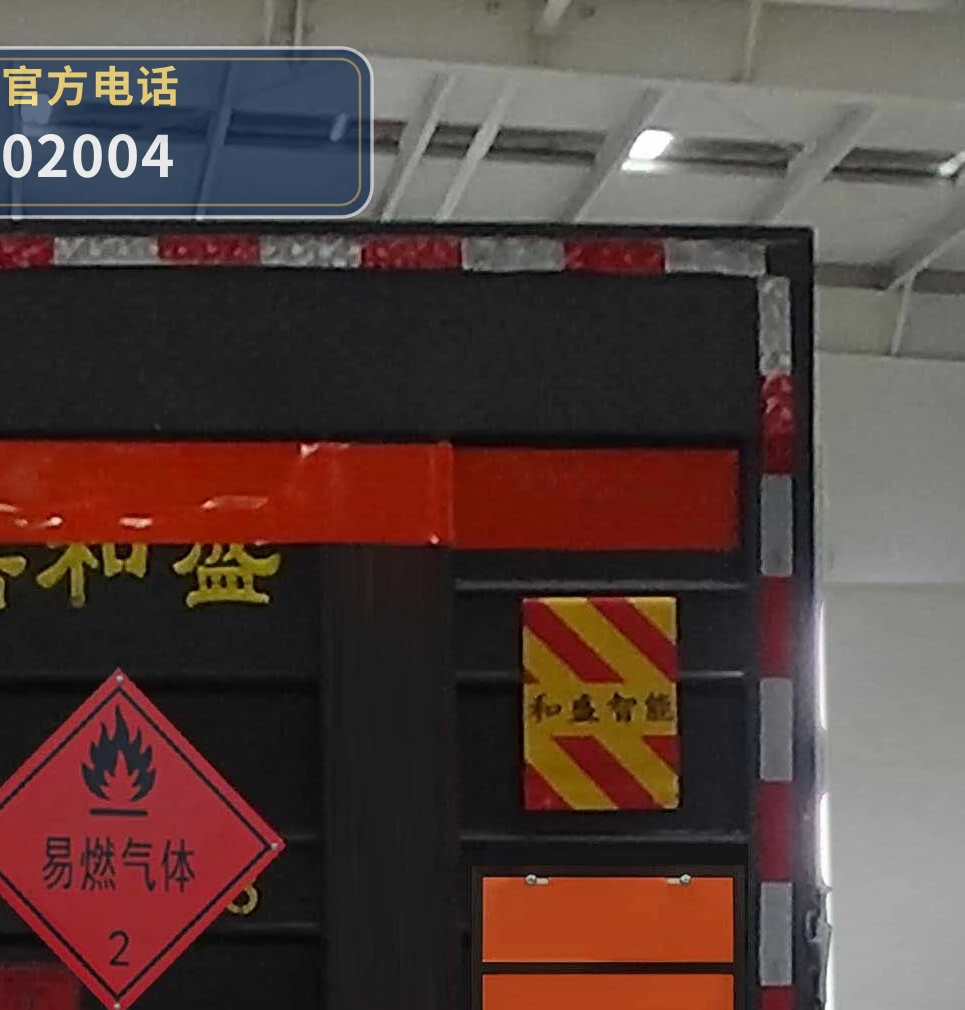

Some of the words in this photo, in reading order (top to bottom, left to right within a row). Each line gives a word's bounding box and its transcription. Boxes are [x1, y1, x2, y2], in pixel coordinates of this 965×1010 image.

[42, 836, 196, 893] 易燃气体
[108, 930, 130, 967] 2
